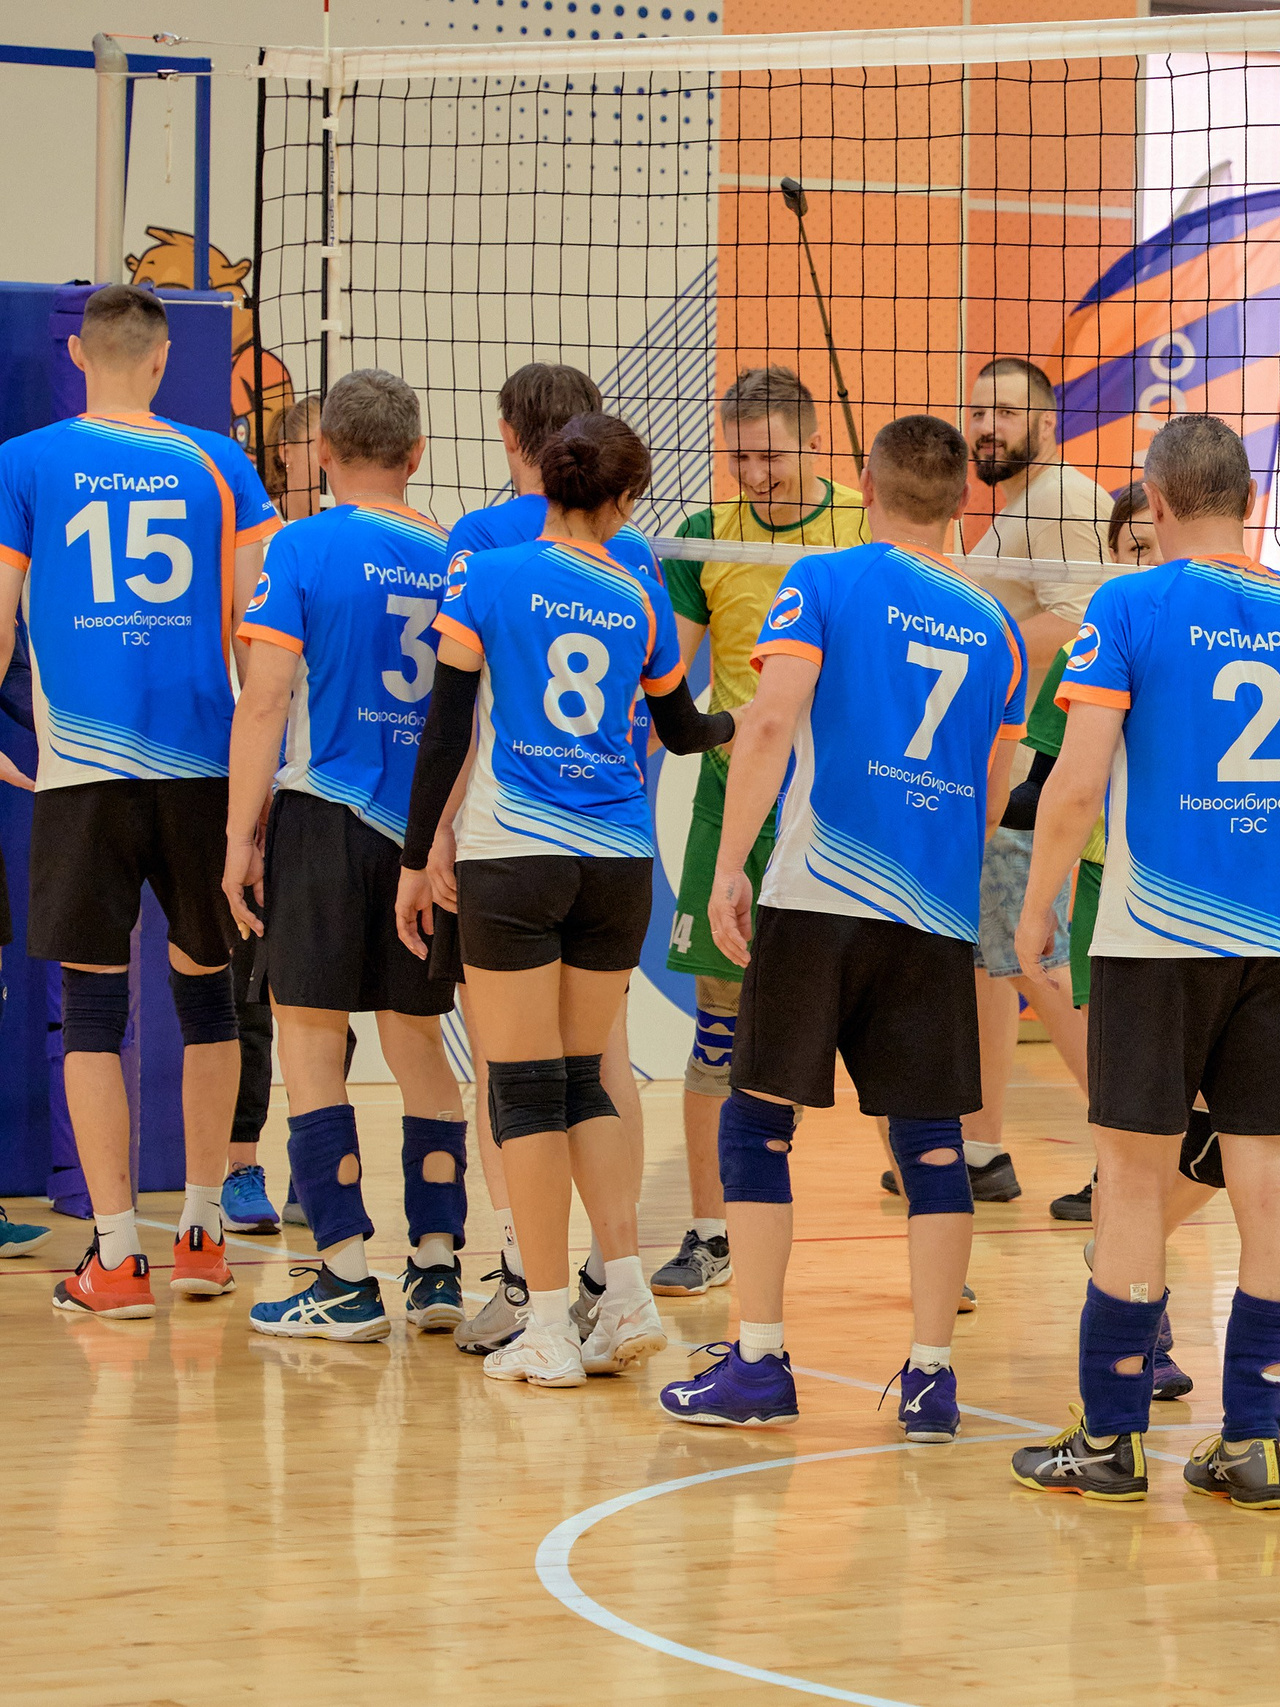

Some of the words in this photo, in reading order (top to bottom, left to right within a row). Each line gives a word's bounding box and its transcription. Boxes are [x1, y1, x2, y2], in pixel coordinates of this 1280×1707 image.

[74, 472, 179, 493] РусГидро
[65, 499, 194, 604] 15
[363, 562, 448, 591] РусГидр
[73, 610, 192, 630] Новосибирская
[530, 594, 637, 630] РусГидро
[887, 605, 987, 647] РусГидро
[122, 631, 151, 646] ГЭС
[381, 593, 438, 703] 3
[543, 632, 610, 737] 8
[904, 640, 969, 760] 7
[512, 739, 626, 765] Новосибская
[559, 764, 596, 779] ГЭС
[868, 759, 976, 799] Новосибирска
[905, 790, 940, 812] ГЭС
[1230, 817, 1268, 834] ГЭС
